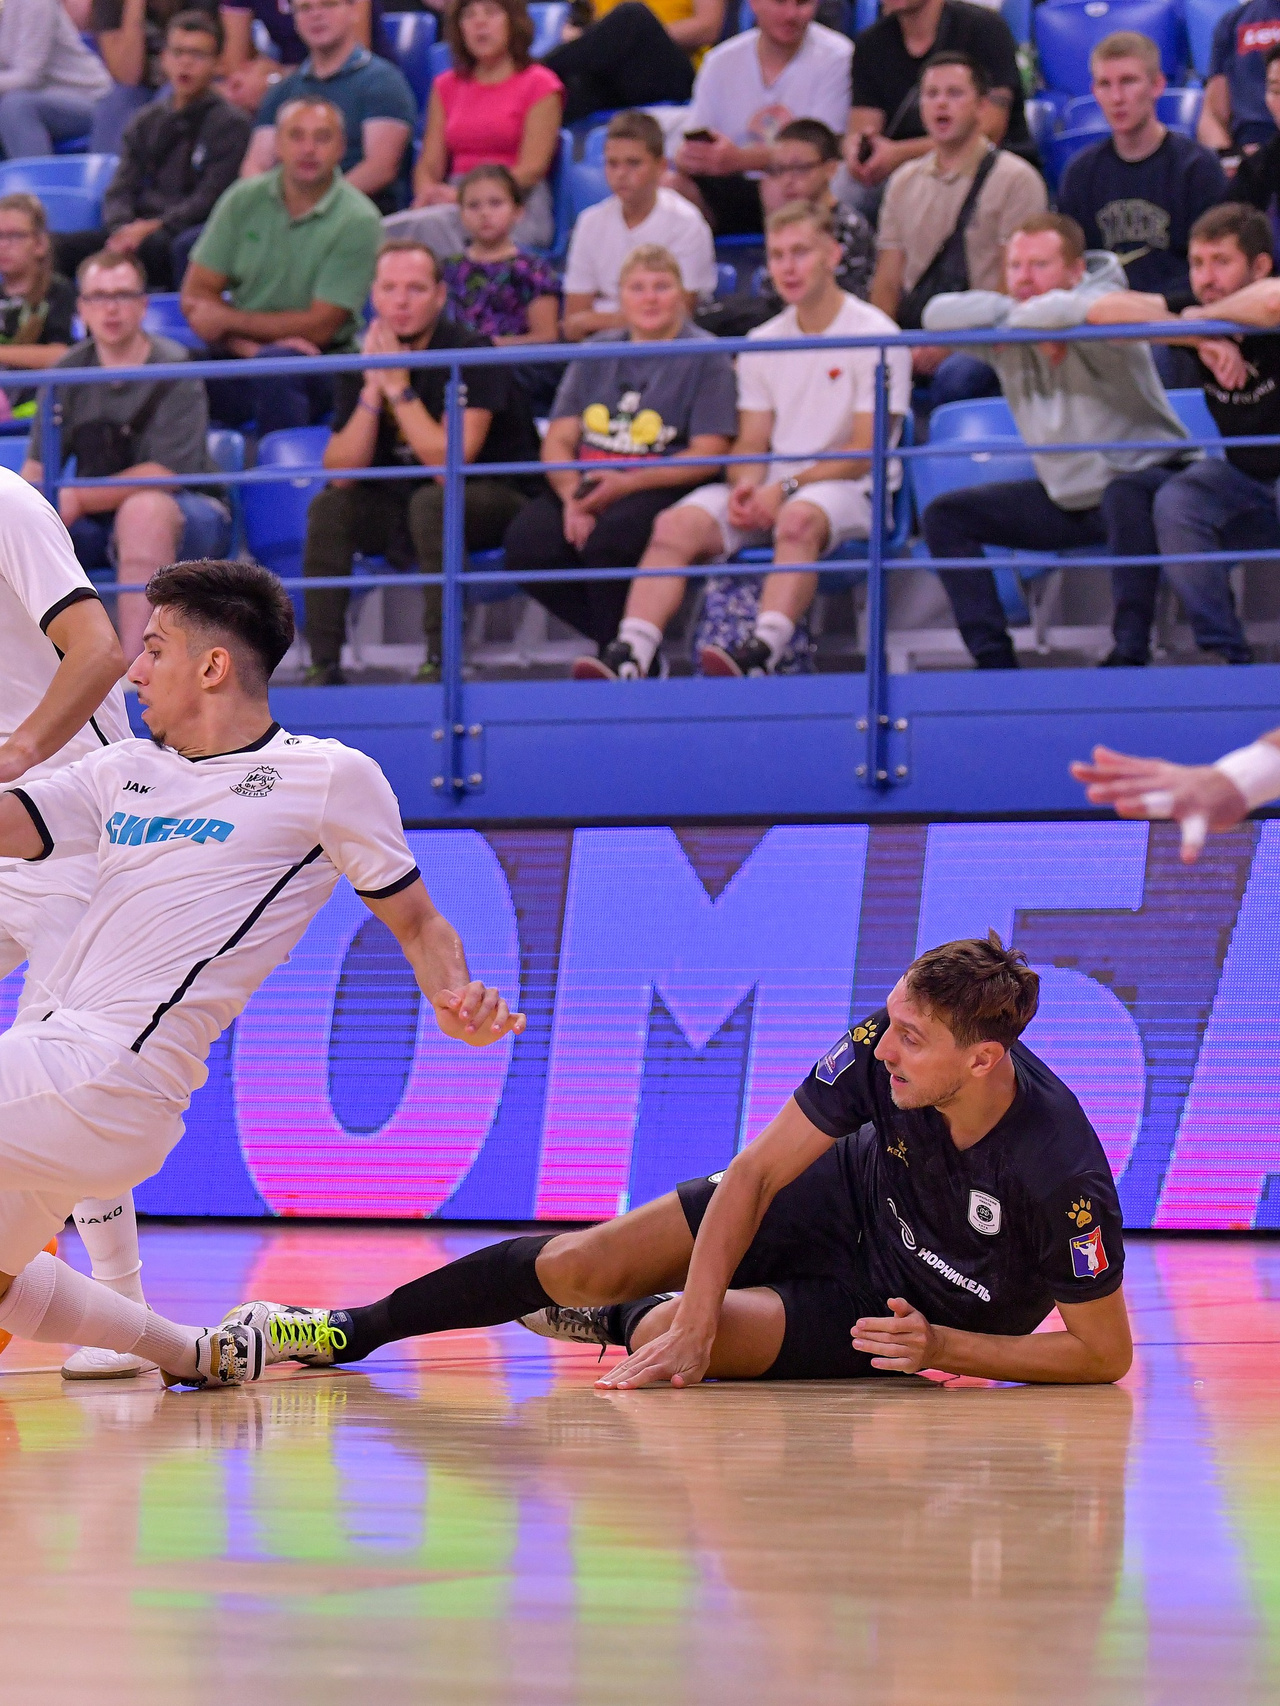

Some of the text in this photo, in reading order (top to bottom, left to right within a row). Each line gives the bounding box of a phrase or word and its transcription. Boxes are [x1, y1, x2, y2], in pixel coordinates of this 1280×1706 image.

[122, 780, 157, 794] JAK
[105, 811, 235, 847] СИБУР
[79, 1205, 123, 1225] JAKO
[917, 1247, 991, 1302] НОРНИКЕЛЬ
